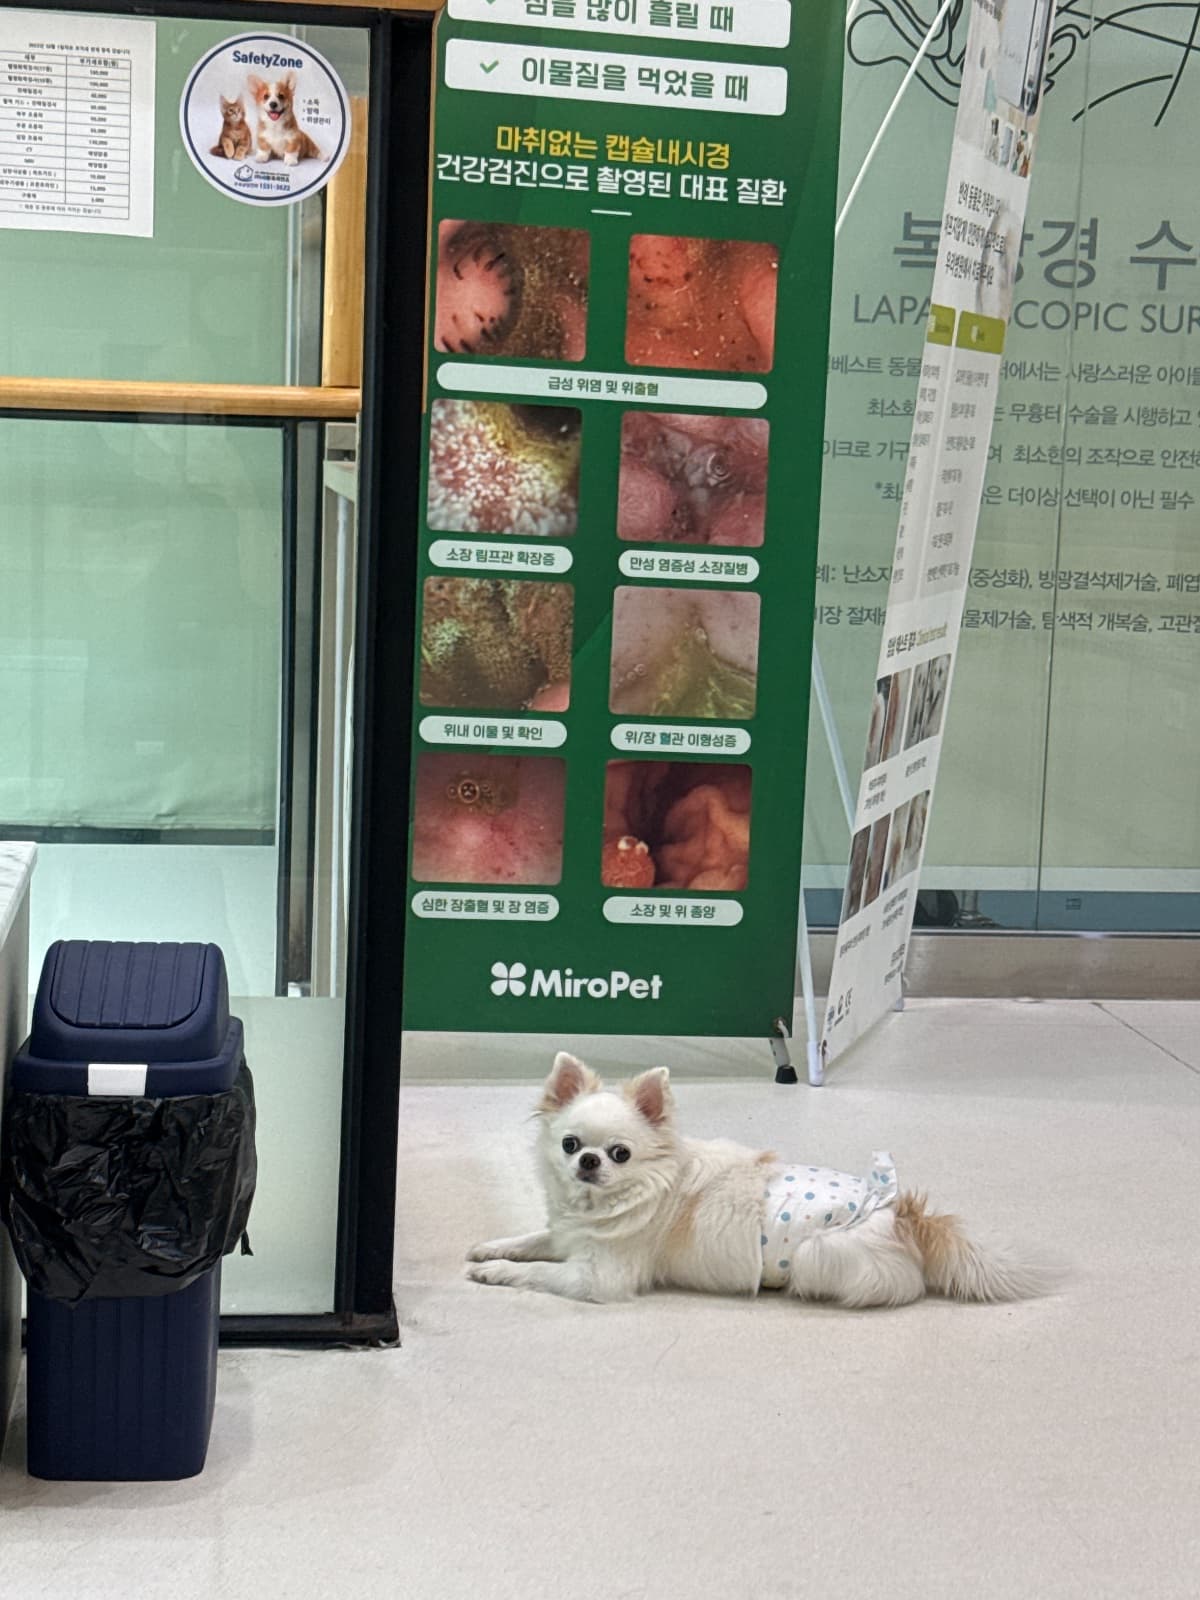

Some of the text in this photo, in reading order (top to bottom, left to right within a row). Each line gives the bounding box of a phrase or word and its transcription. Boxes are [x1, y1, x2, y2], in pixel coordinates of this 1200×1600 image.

[586, 0, 637, 25] 많이
[648, 0, 699, 30] 흘릴
[709, 6, 734, 33] 때
[232, 50, 303, 69] SafetyZone
[521, 57, 749, 103] 이물질을 먹었을 때
[496, 126, 731, 171] 마취없는 캡슐내시경
[437, 153, 787, 207] 건강검진으로 촬영된 대표 질환
[893, 211, 1098, 288] 복경
[1066, 362, 1152, 385] 사랑스러운
[548, 376, 659, 396] 급성 위염 및 위출혈
[1009, 402, 1062, 424] 무흉터
[1069, 404, 1119, 426] 수술을
[1123, 405, 1193, 428] 시행하고
[1013, 444, 1083, 466] 최소한의
[1086, 448, 1157, 468] 조작으로
[1008, 487, 1060, 508] 더이상
[1065, 488, 1117, 510] 선택이
[1121, 489, 1155, 511] 아닌
[1161, 490, 1196, 511] 필수
[446, 547, 556, 567] 소장 림프관 확장증
[630, 556, 749, 577] 만성 염증성 소장질병
[1039, 569, 1160, 593] 방광결석제거술,
[1097, 612, 1154, 635] 개복술,
[443, 723, 543, 742] 위내 이물 및 확인
[624, 730, 737, 748] 위/장 혈관 이형성증
[421, 897, 549, 915] 심한 장출혈 및 장 염증
[630, 903, 716, 920] 소장 및 위 종양
[529, 967, 663, 1000] MiroPet
